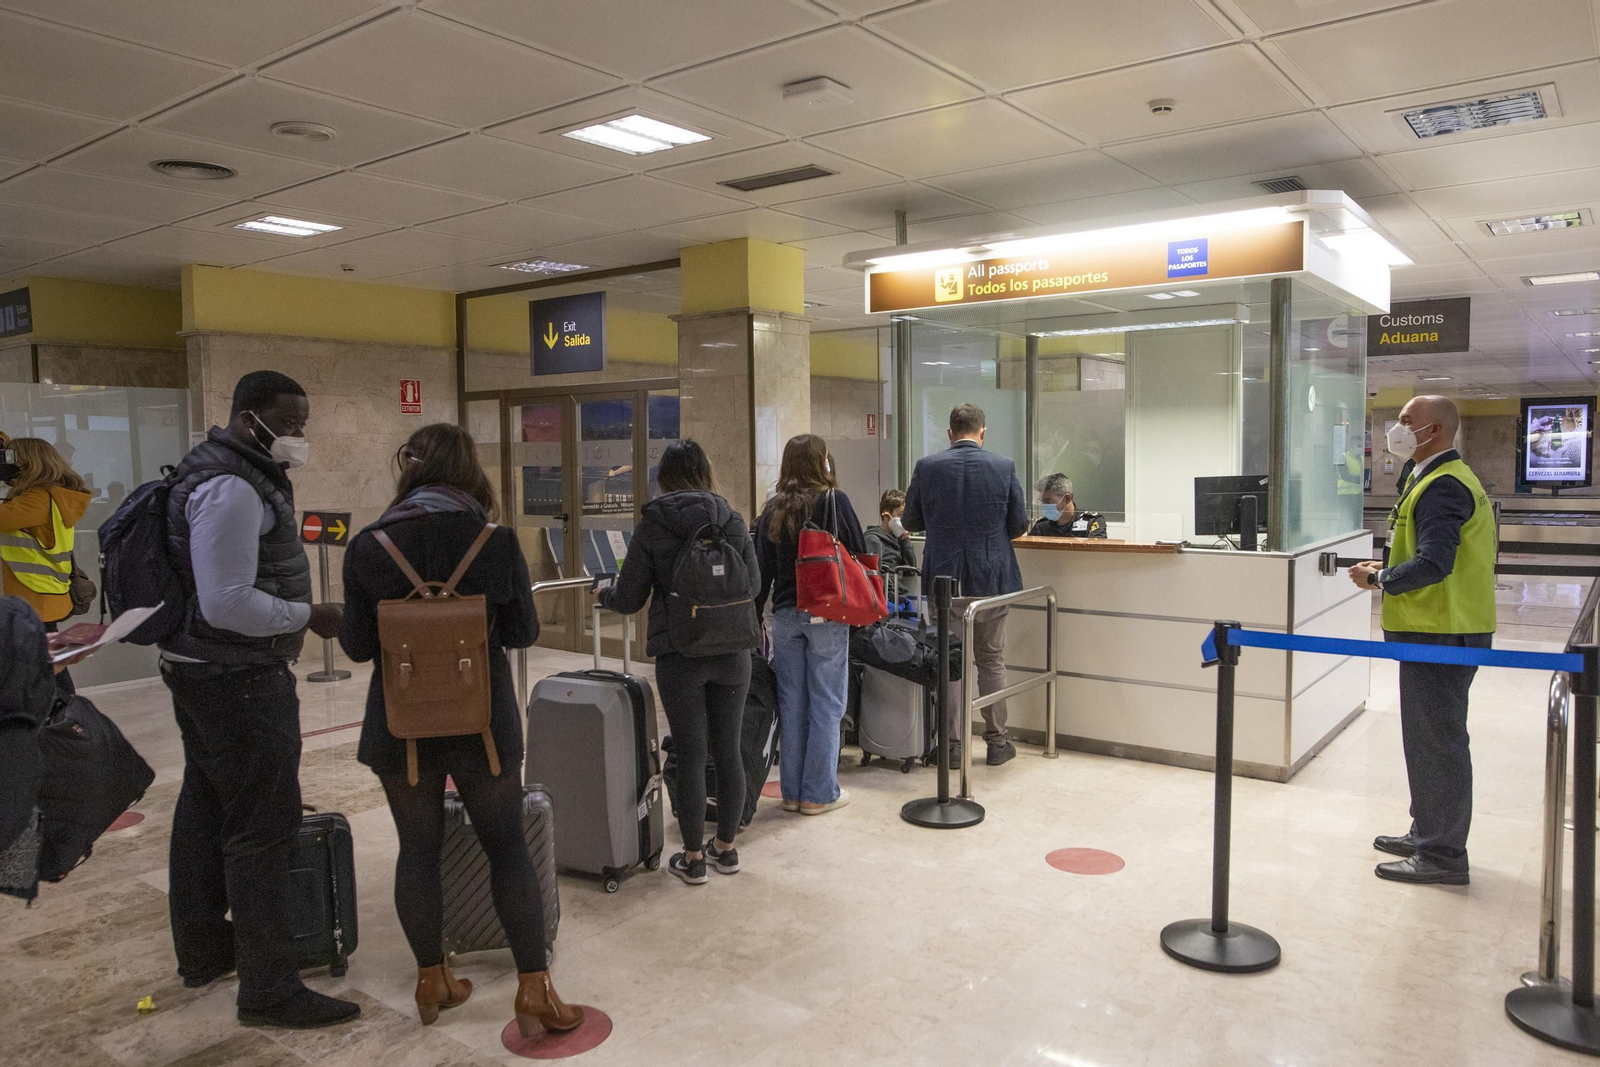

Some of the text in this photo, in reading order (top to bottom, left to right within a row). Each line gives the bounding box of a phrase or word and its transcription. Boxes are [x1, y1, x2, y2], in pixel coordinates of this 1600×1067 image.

[1176, 247, 1199, 255] TODOS
[967, 258, 1050, 279] All passports
[1168, 261, 1208, 271] PASAPORTES
[967, 271, 1109, 296] Todos los pasaportes
[563, 321, 576, 332] Exit
[1379, 313, 1444, 328] Customs
[564, 333, 591, 347] Salida
[1379, 331, 1439, 345] Aduana
